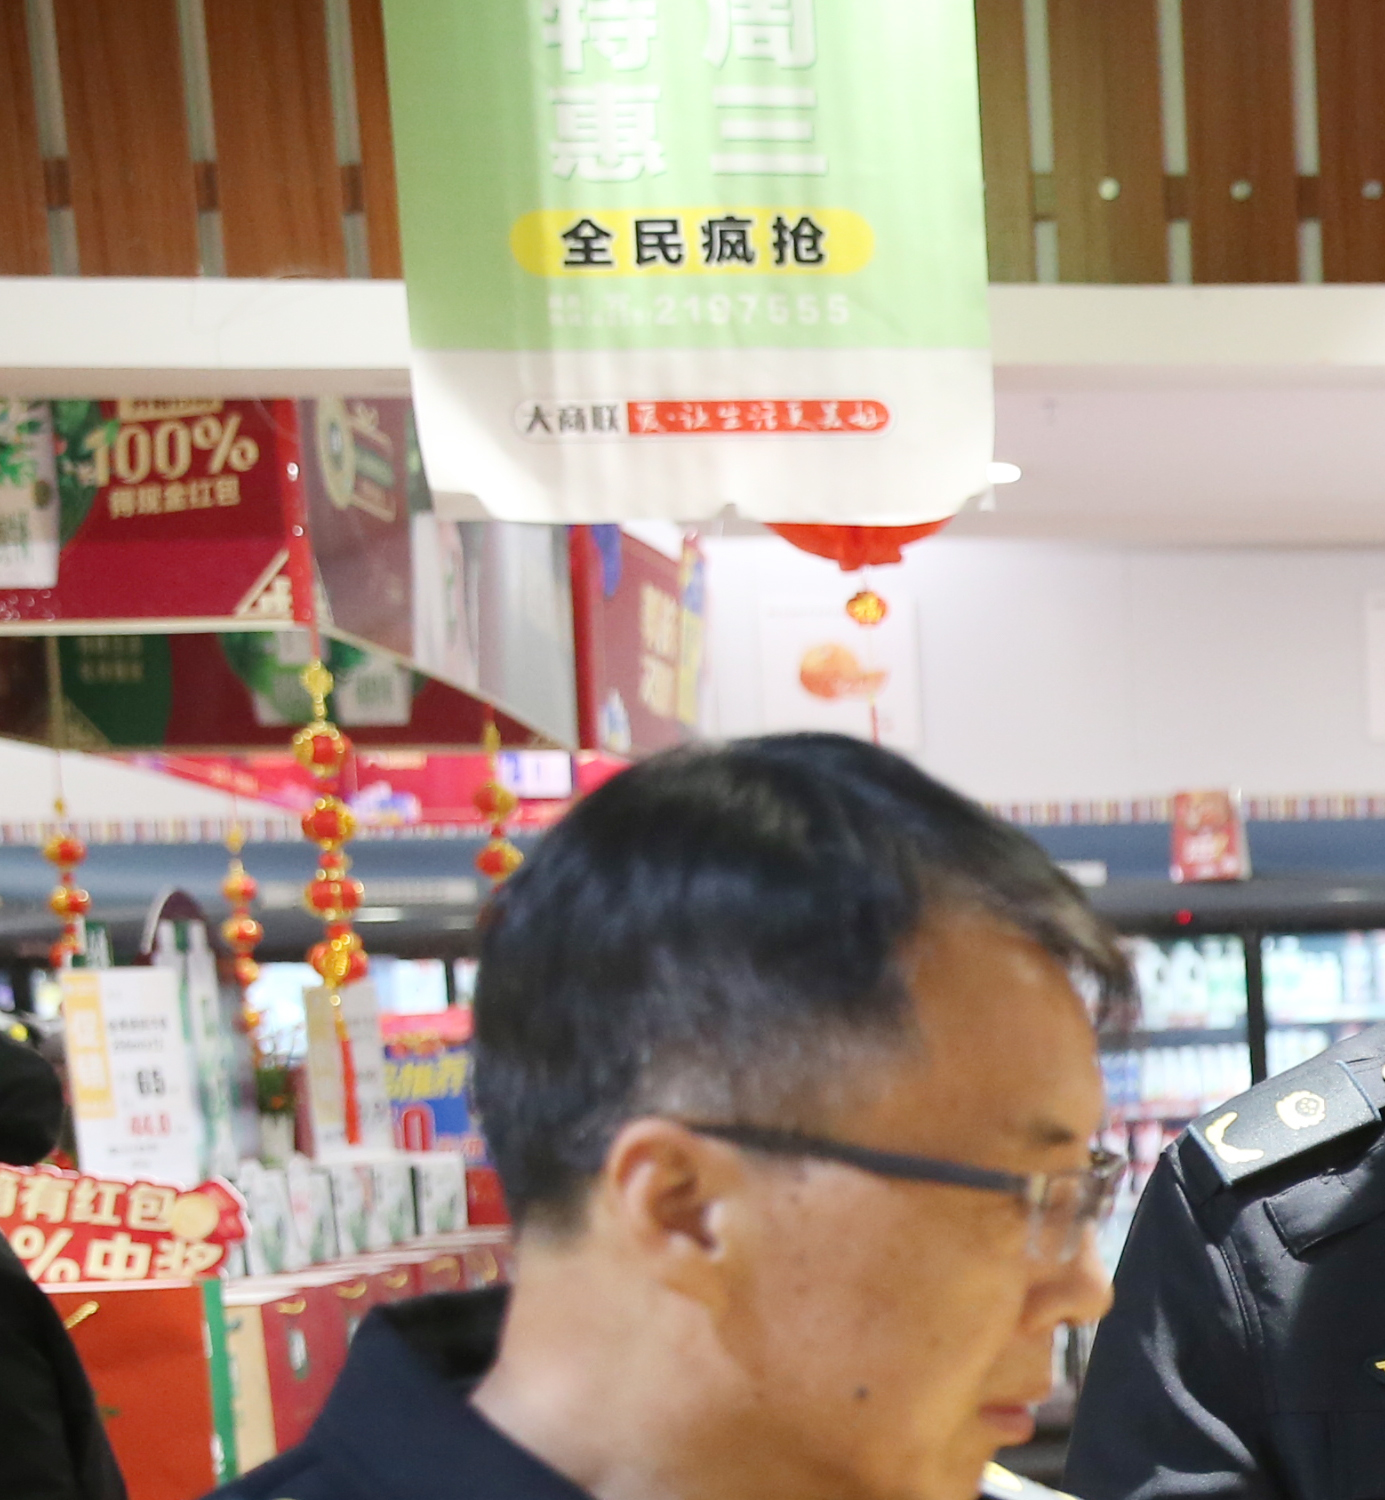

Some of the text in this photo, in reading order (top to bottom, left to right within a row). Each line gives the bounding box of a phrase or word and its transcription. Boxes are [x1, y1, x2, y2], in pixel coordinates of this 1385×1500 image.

[543, 0, 667, 183] 特惠
[703, 0, 829, 177] 周三
[562, 215, 825, 267] 全民疯抢
[526, 402, 619, 435] 大商联
